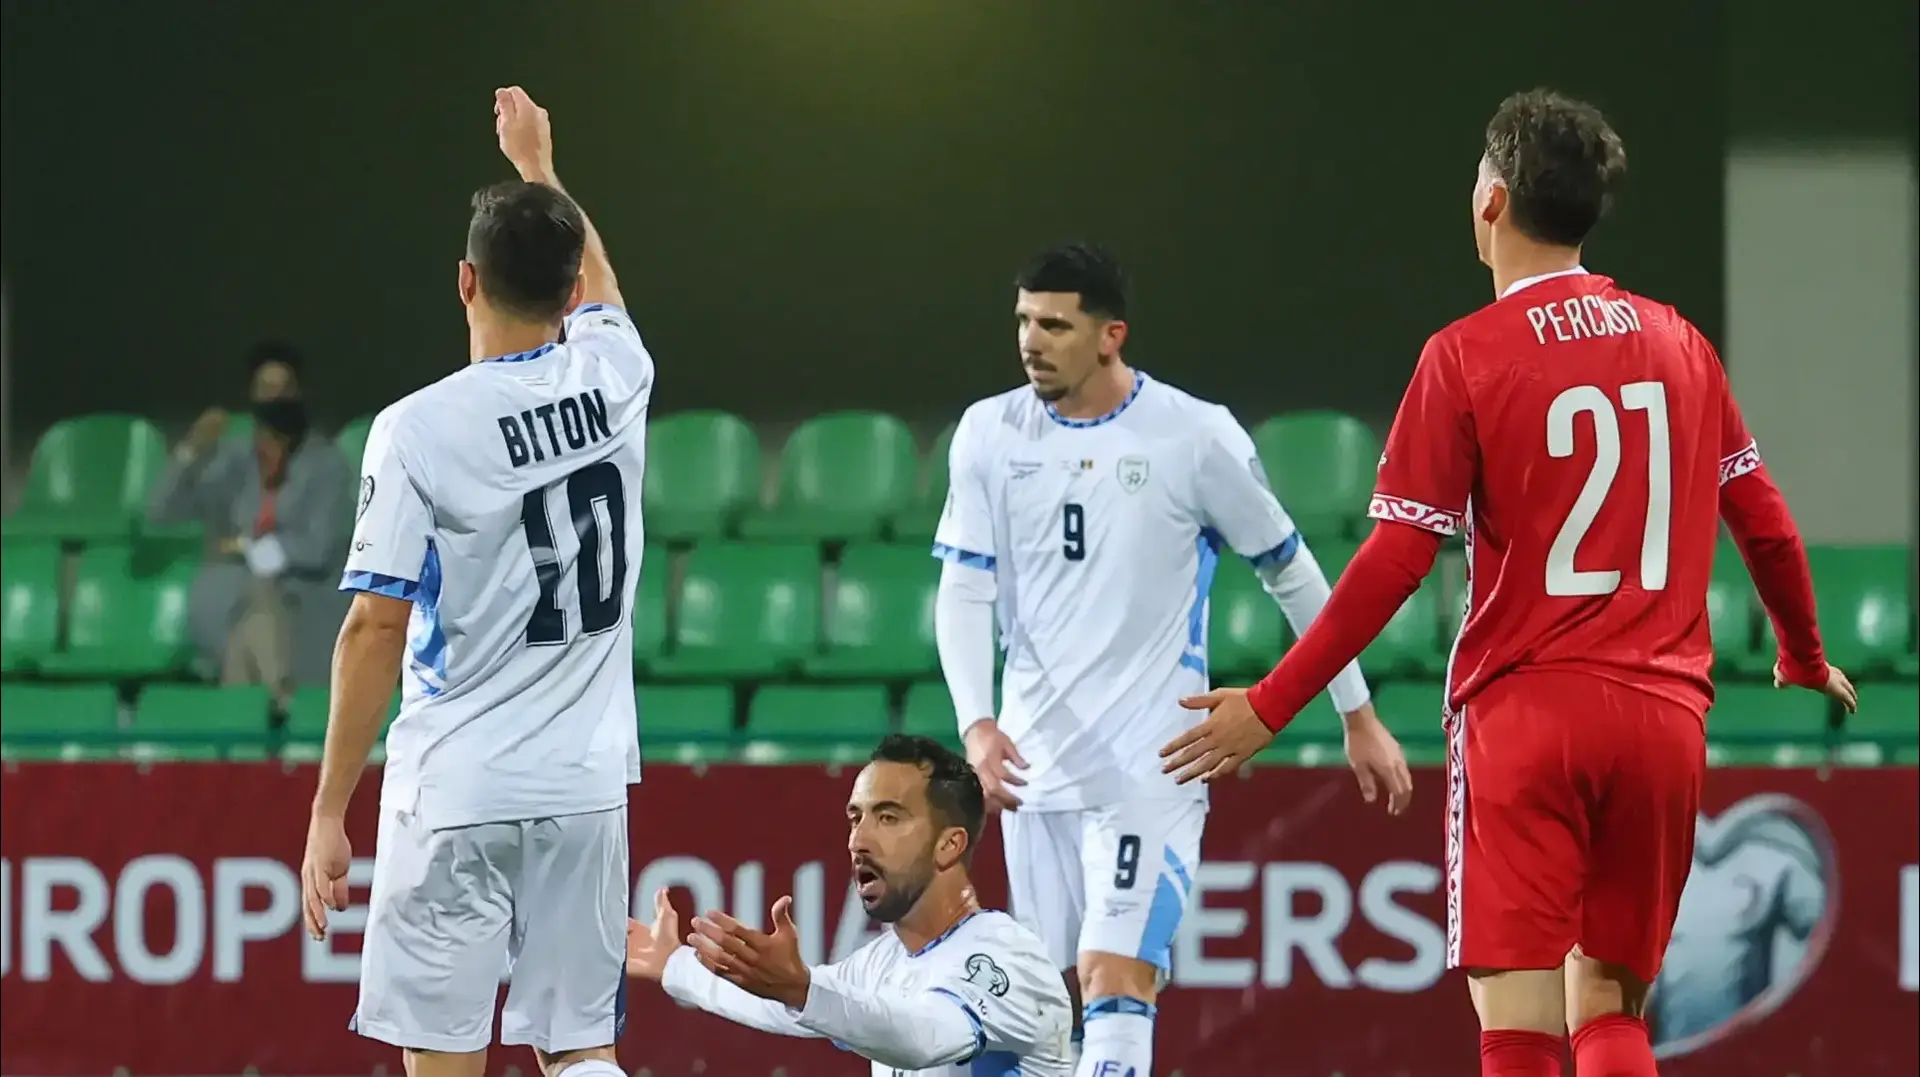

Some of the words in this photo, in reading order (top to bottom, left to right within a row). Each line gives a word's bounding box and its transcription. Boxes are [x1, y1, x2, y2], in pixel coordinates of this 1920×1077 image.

[498, 389, 612, 468] BITON
[1063, 503, 1086, 561] 9
[1545, 381, 1671, 598] 21
[520, 461, 628, 648] 10
[1114, 834, 1141, 890] 9
[1, 854, 371, 984] ROPE
